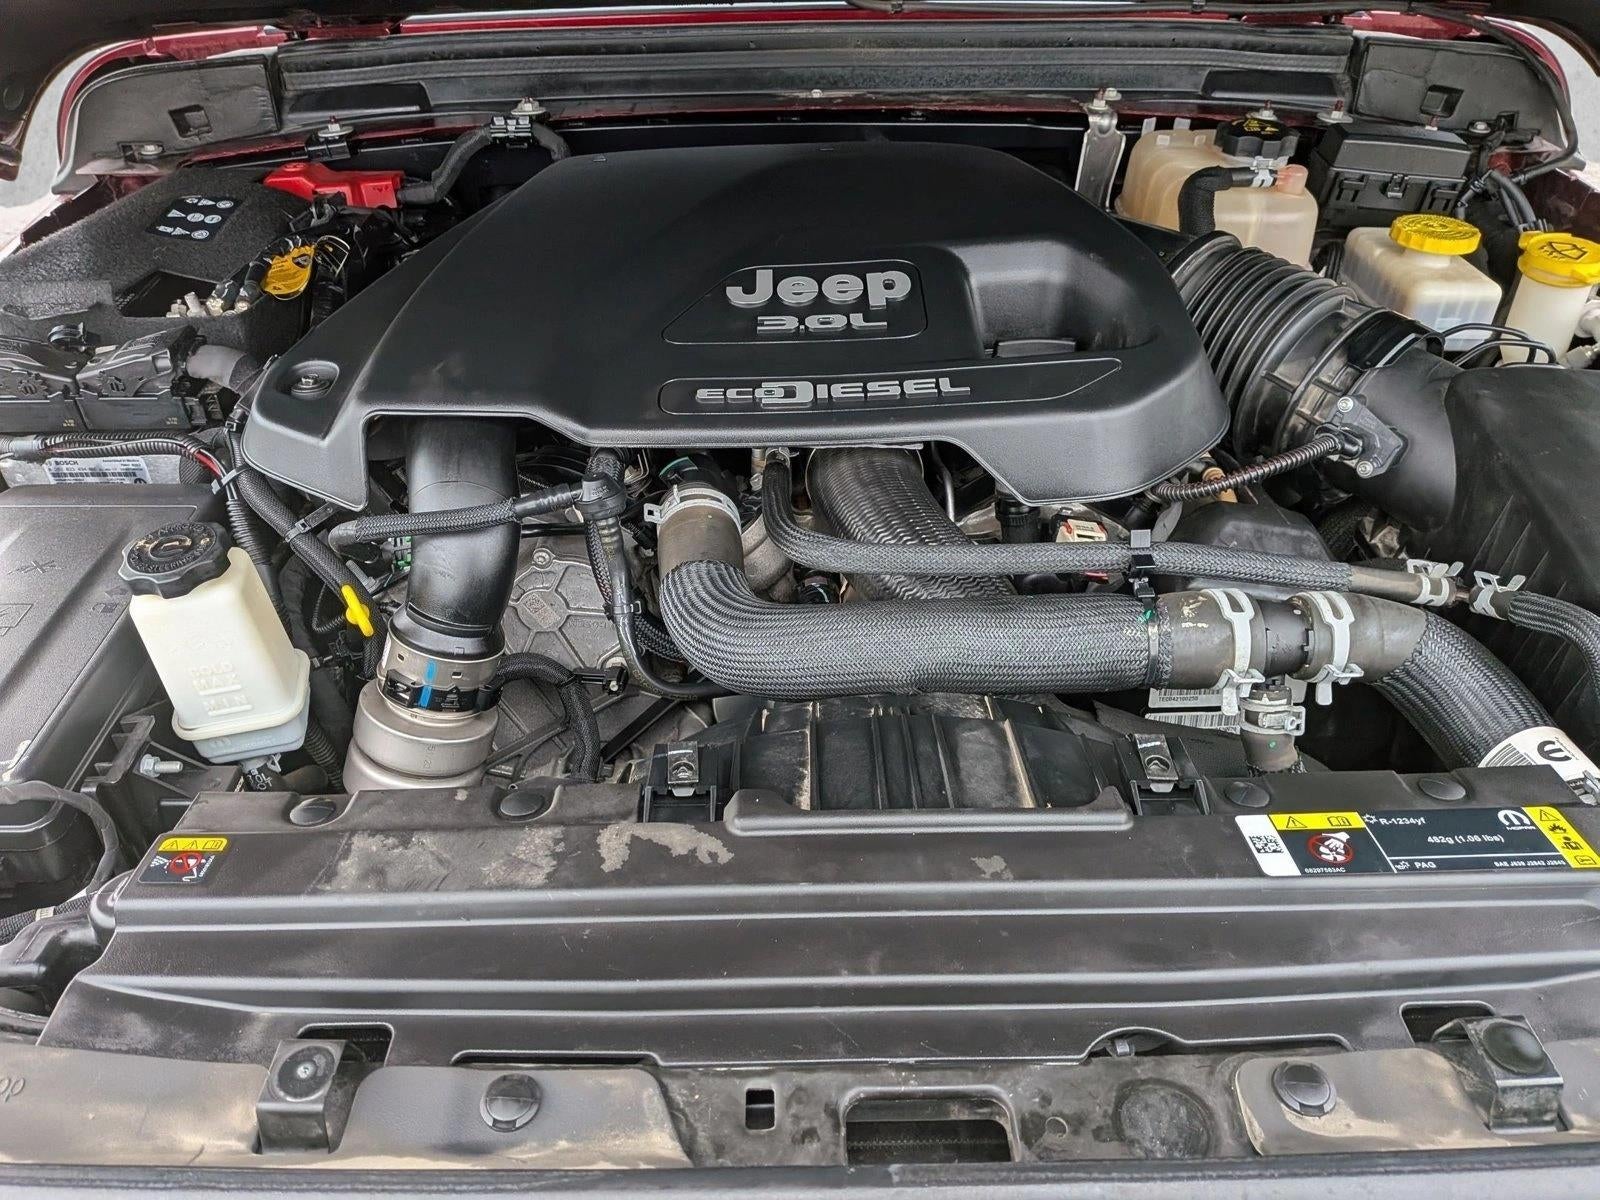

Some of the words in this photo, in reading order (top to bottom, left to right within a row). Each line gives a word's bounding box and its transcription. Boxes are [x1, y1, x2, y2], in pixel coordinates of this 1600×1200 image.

[726, 269, 911, 310] Jeep
[757, 312, 888, 334] 3.0L
[1379, 816, 1426, 826] R-1234yf
[1481, 833, 1505, 843] lbs)
[1414, 861, 1437, 869] PAG
